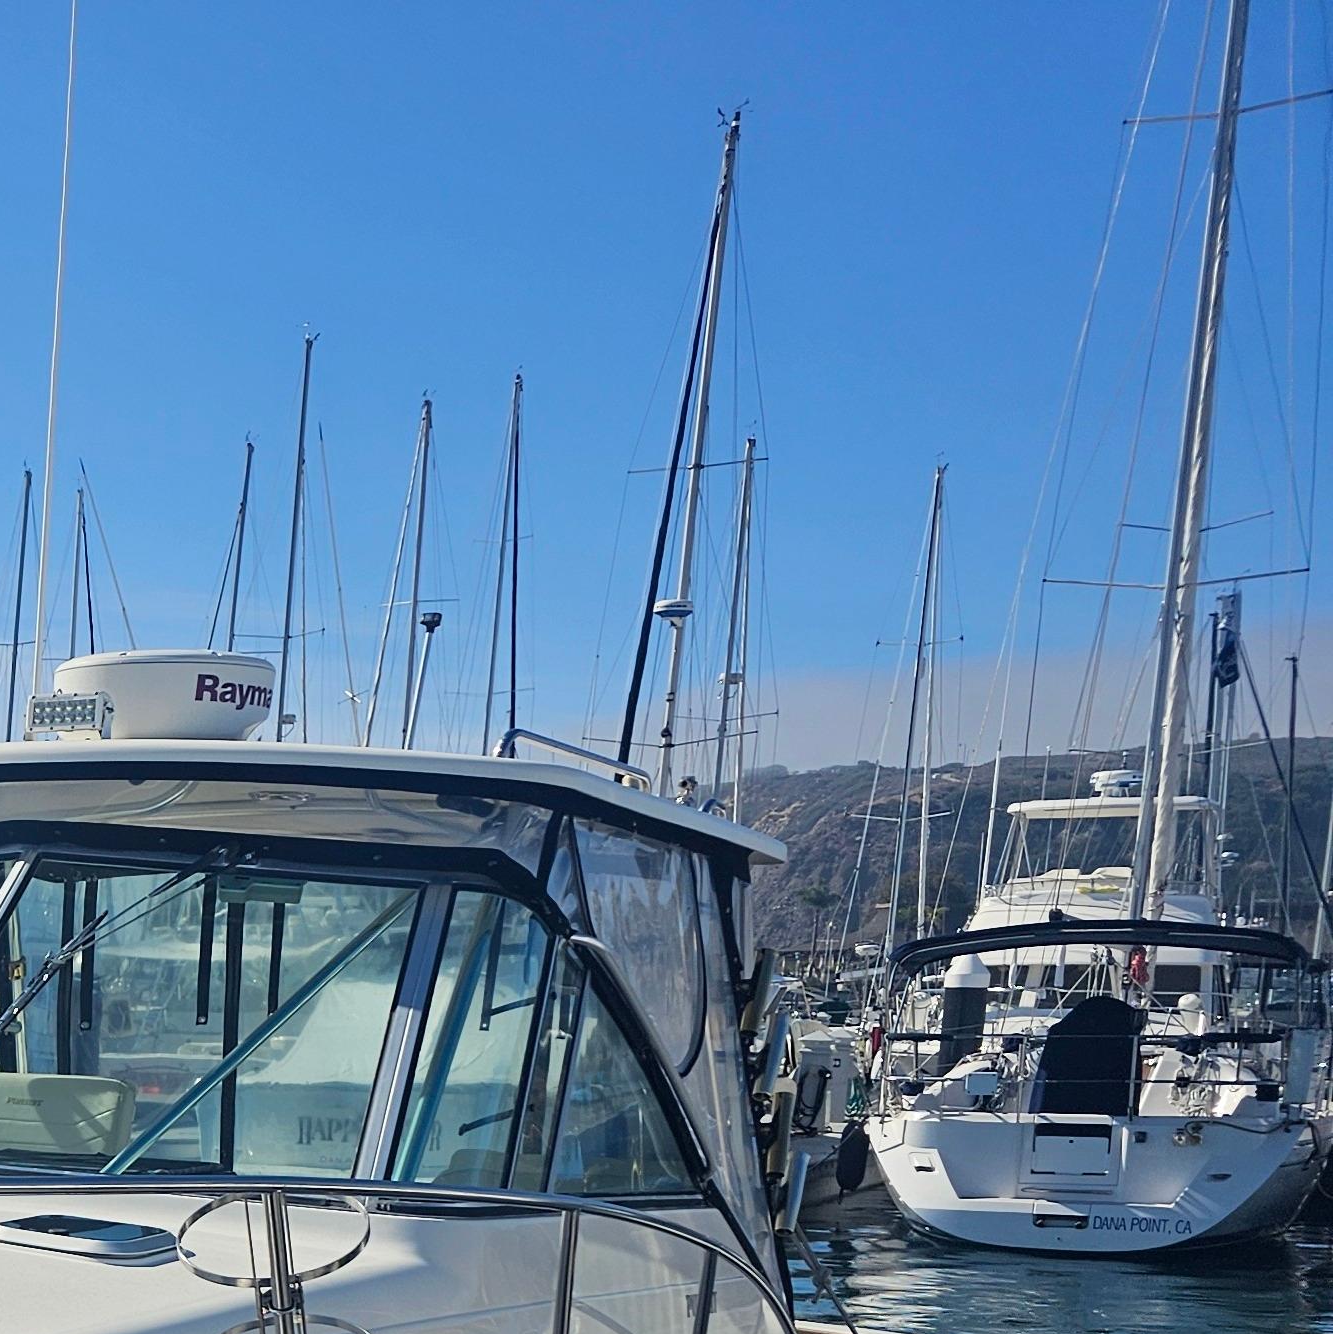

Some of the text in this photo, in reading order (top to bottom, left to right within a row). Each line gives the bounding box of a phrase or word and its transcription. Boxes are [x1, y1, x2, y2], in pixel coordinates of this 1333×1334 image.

[296, 1115, 358, 1146] HAPP
[1093, 1216, 1192, 1235] DANA POINT, CA
